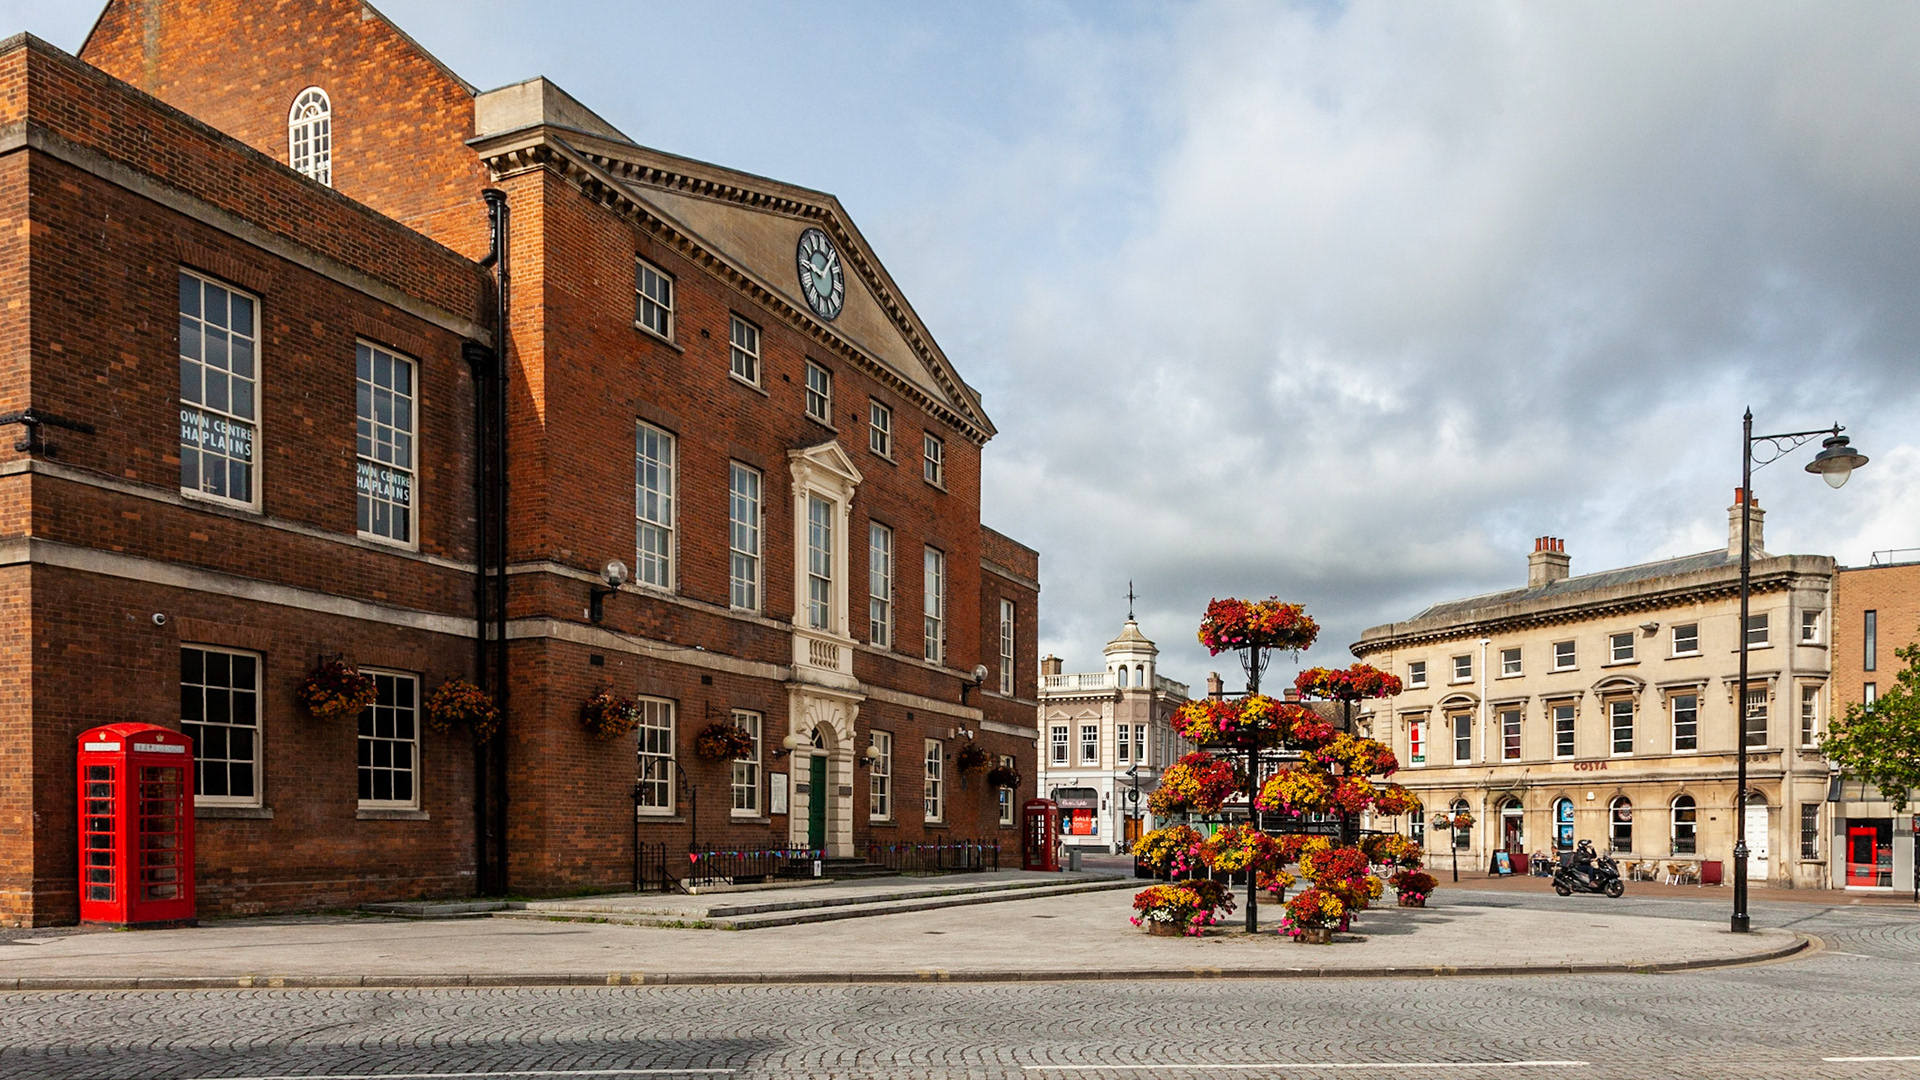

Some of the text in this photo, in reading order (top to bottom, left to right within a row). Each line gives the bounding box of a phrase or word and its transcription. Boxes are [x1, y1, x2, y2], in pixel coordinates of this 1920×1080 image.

[180, 424, 251, 456] HAPLAINS
[213, 420, 252, 441] CENTRE
[380, 470, 410, 488] CENTRE
[1573, 761, 1608, 771] COSTA
